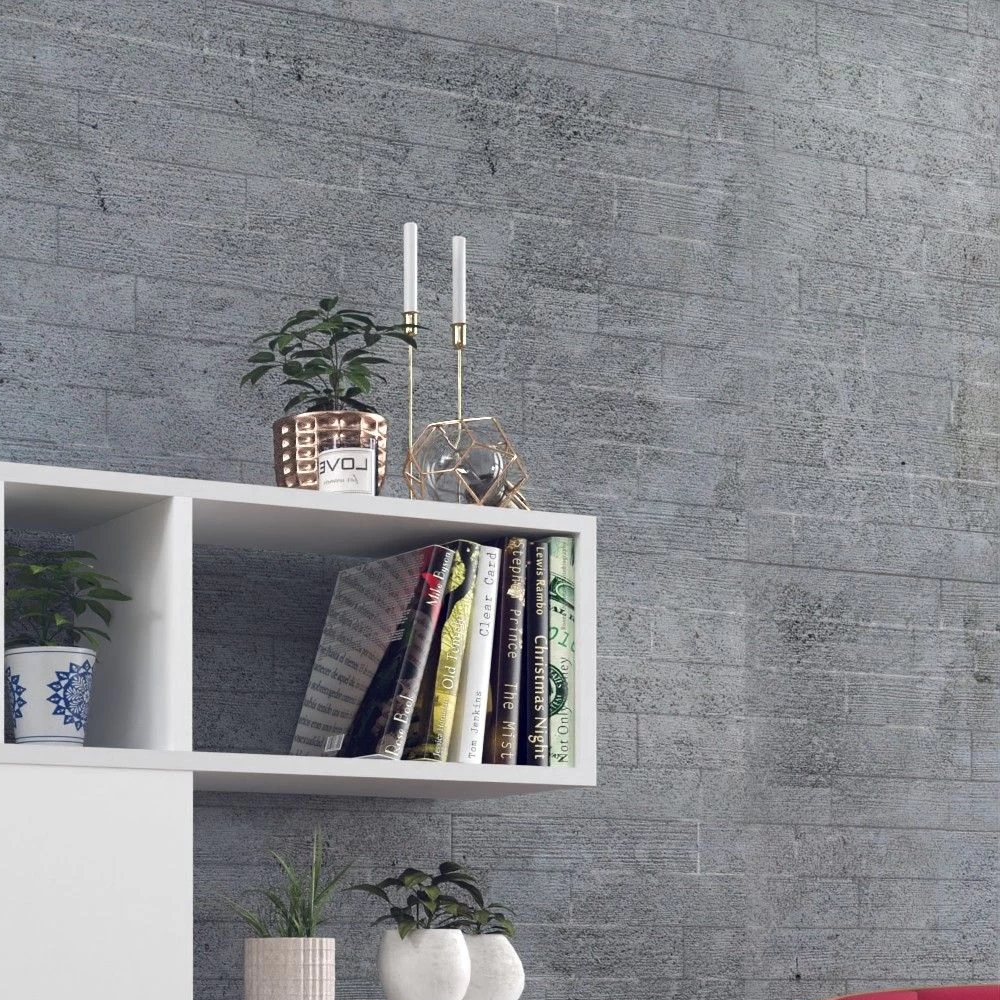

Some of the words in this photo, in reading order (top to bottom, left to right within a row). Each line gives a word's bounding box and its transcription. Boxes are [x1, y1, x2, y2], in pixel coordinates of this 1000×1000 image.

[484, 552, 497, 585] Card
[535, 546, 546, 576] Lewis
[426, 583, 443, 606] Mike
[535, 579, 546, 616] Rambo
[479, 594, 493, 637] Clear
[507, 609, 522, 660] Prince
[442, 665, 457, 691] Old
[534, 635, 548, 712] Christmas
[470, 690, 483, 734] Jenkins
[503, 683, 518, 710] The
[557, 706, 573, 735] Only
[467, 740, 479, 760] Tom
[500, 720, 516, 759] Mist
[527, 717, 548, 760] Night
[558, 740, 569, 763] Not
